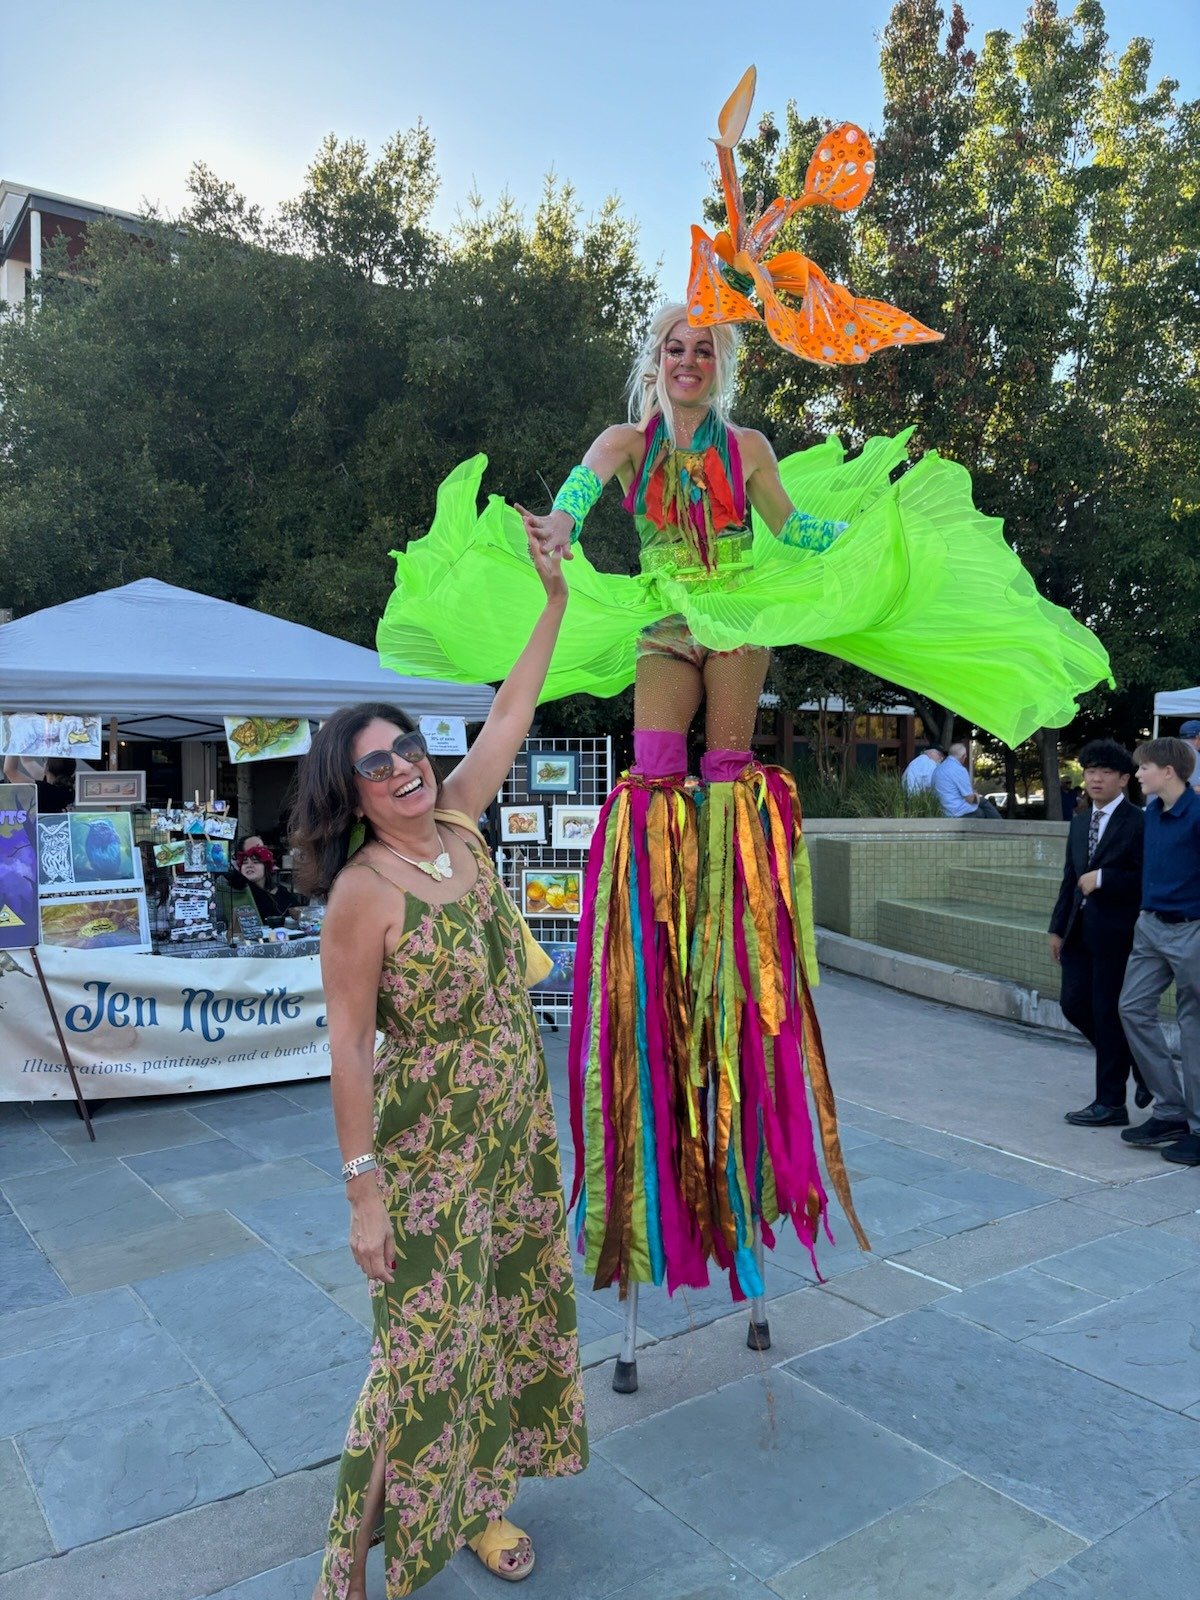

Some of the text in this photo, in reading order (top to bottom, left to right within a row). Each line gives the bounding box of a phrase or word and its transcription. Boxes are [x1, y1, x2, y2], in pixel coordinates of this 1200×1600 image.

[65, 981, 305, 1042] Jen Noelle
[142, 1055, 222, 1074] paintings,
[227, 1049, 257, 1063] and
[260, 1050, 270, 1060] a
[274, 1041, 317, 1058] bunch
[322, 1042, 331, 1055] o
